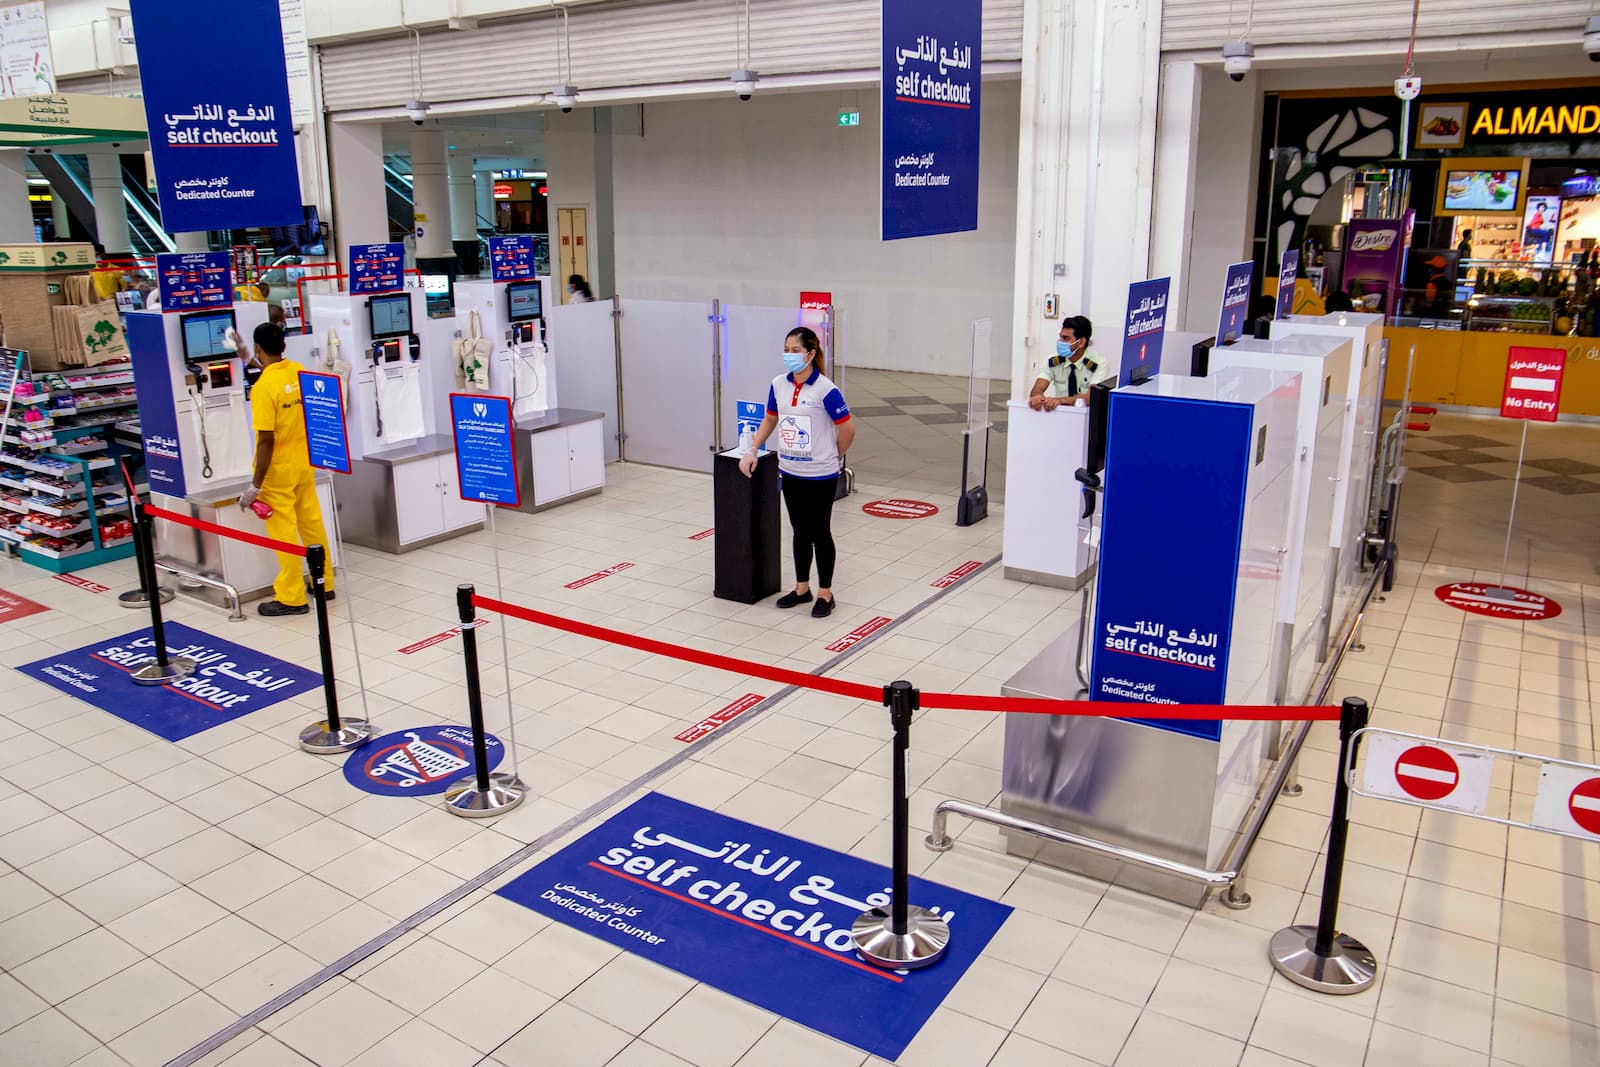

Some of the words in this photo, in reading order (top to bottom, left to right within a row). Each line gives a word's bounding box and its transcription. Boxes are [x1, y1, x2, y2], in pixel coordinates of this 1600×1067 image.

[895, 35, 937, 71] الذاتي
[939, 41, 971, 75] الدفع
[896, 71, 921, 97] self
[921, 74, 971, 105] checkout
[164, 103, 223, 127] الذاتي
[228, 104, 275, 127] الدفع
[1471, 104, 1600, 136] ALMAND
[167, 127, 200, 145] self
[202, 127, 279, 145] checkout
[894, 153, 919, 169] مخصص
[919, 153, 935, 169] كاونتر
[174, 178, 207, 190] مخصص
[207, 176, 229, 189] كاونتر
[895, 172, 926, 187] Dedicated
[927, 173, 951, 187] Counter
[176, 188, 220, 201] Dedicated
[221, 187, 255, 199] Counter
[1510, 360, 1537, 370] الدخول
[1536, 362, 1562, 373] ممنوع
[1506, 397, 1522, 408] No
[1523, 398, 1555, 413] Entry
[1106, 620, 1164, 638] الذاتي
[1166, 628, 1218, 648] الدفع
[1105, 636, 1138, 652] self
[1138, 641, 1217, 668] checkout
[41, 666, 74, 687] Dedicated
[70, 677, 99, 693] Counter
[199, 662, 296, 692] الدفع
[1102, 675, 1134, 689] مخصص
[1101, 683, 1145, 701] Dedicated
[1134, 682, 1156, 693] كاونتر
[631, 825, 802, 885] الذاتي
[553, 882, 605, 904] مخصص
[540, 889, 610, 923] Dedicated
[607, 917, 666, 946] Counter
[598, 846, 699, 887] self
[688, 874, 909, 976] checko
[601, 901, 643, 918] كاونتر
